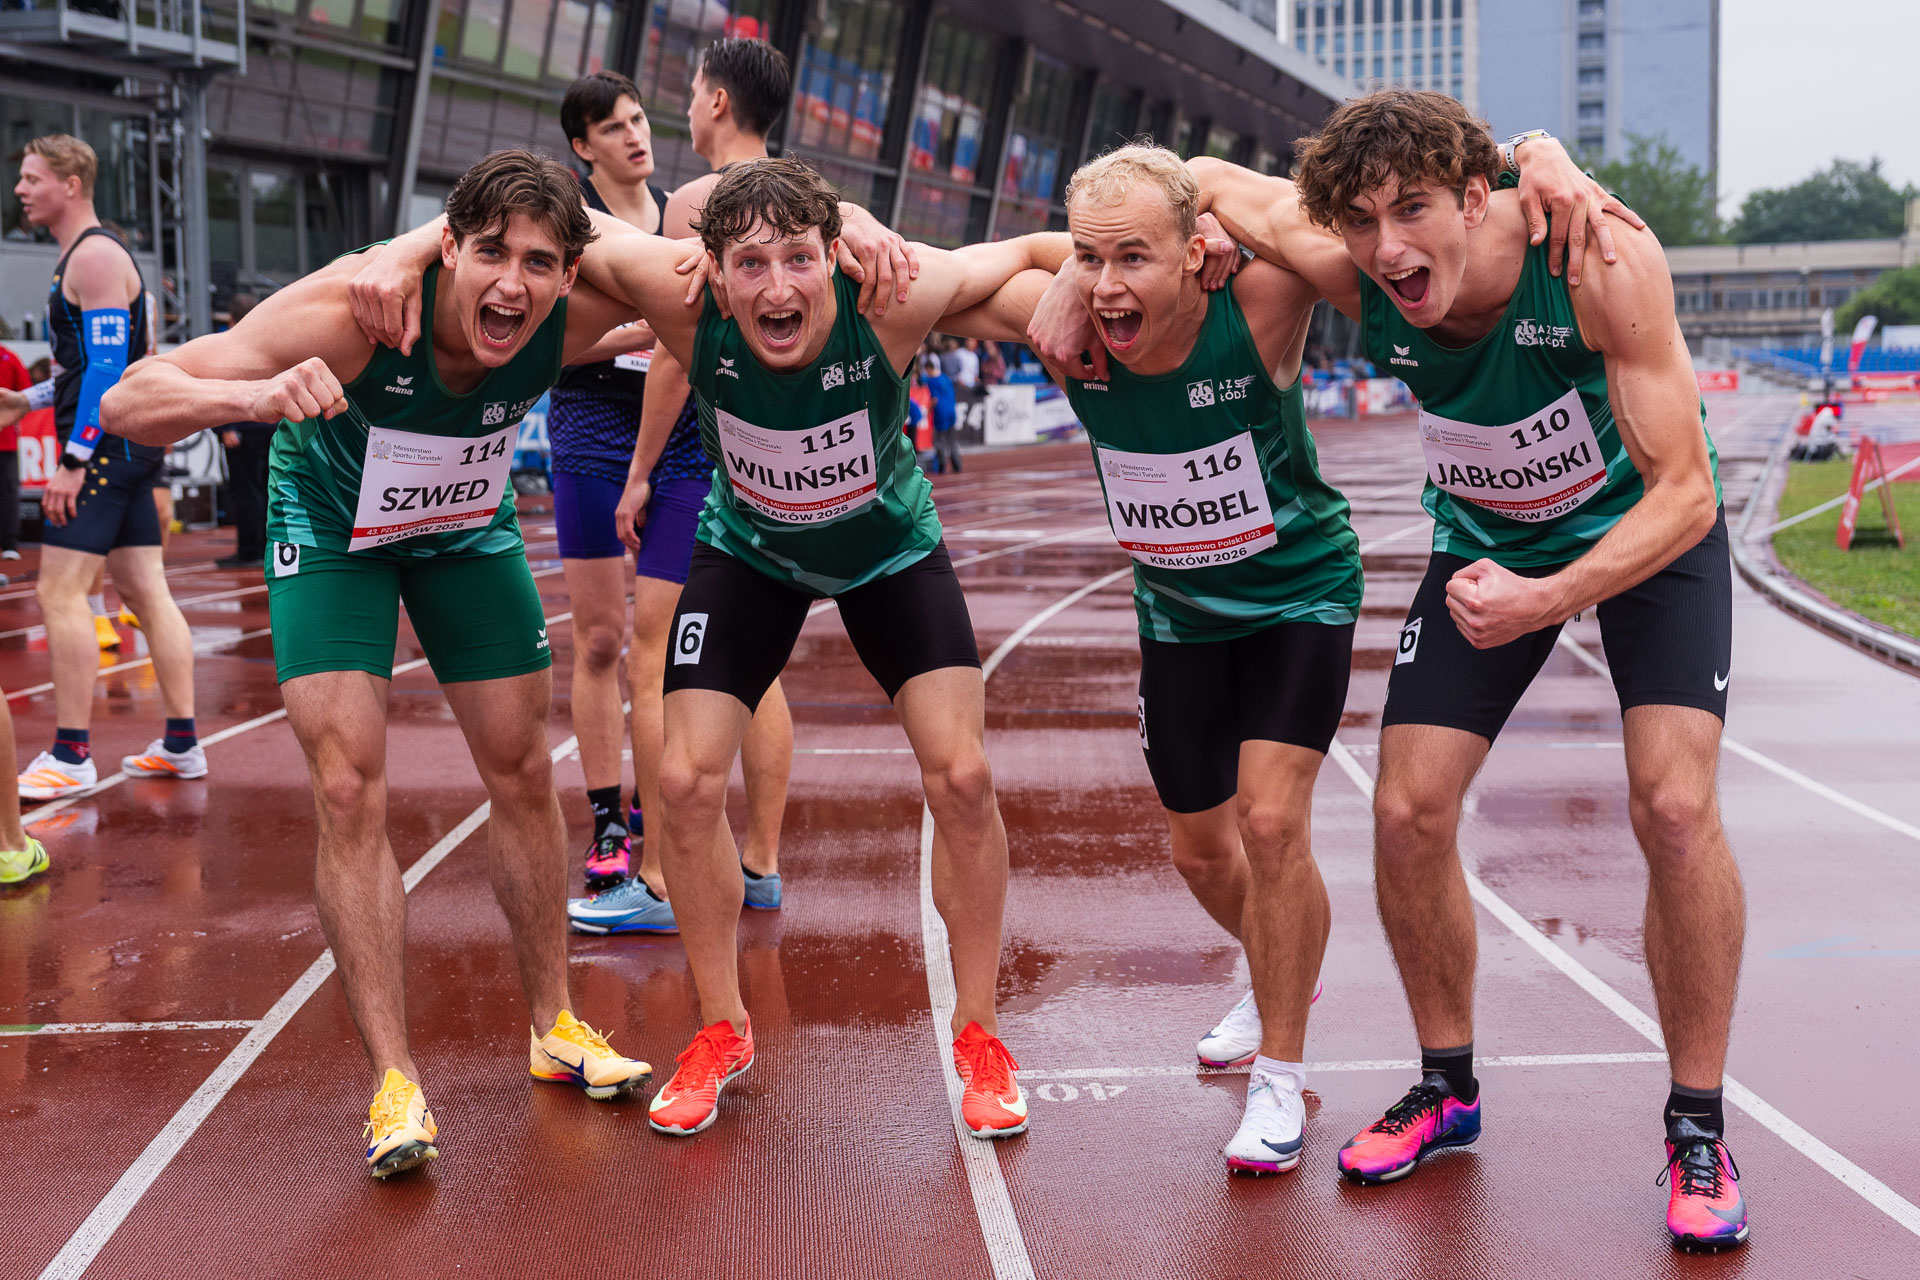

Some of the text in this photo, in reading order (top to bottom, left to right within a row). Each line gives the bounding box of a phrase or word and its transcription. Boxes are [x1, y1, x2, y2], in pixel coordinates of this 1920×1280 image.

[715, 367, 739, 379] erima
[1390, 357, 1419, 367] erima
[384, 385, 414, 396] erima
[1083, 381, 1109, 391] erima
[800, 421, 855, 455] 115
[1509, 408, 1570, 450] 110
[392, 451, 413, 461] Sportu
[416, 453, 443, 462] Turystyki
[393, 444, 432, 455] Ministerstwo
[459, 435, 507, 466] 114
[727, 450, 869, 492] WILIŃSKI
[1120, 463, 1154, 472] Ministerstwo
[1121, 470, 1139, 478] Sportu
[1141, 471, 1167, 479] Turystyki
[1183, 445, 1242, 482] 116
[1437, 440, 1592, 490] JABŁOŃSKI
[379, 478, 490, 512] SZWED
[770, 501, 821, 511] Mistrzostwa
[822, 495, 847, 508] Polski
[848, 488, 864, 500] U23
[1548, 488, 1575, 502] Polski
[1575, 478, 1593, 491] U23
[446, 512, 469, 522] Polski
[469, 510, 485, 518] U23
[755, 502, 849, 521] KRAKÓW 2026
[1115, 489, 1259, 529] WRÓBEL
[1544, 497, 1580, 517] 2026
[376, 521, 465, 545] KRAKÓW 2026
[1164, 543, 1216, 553] Mistrzostwa
[1217, 535, 1243, 548] Polski
[1244, 529, 1262, 541] U23
[1149, 547, 1248, 567] KRAKÓW 2026
[680, 620, 703, 655] 6
